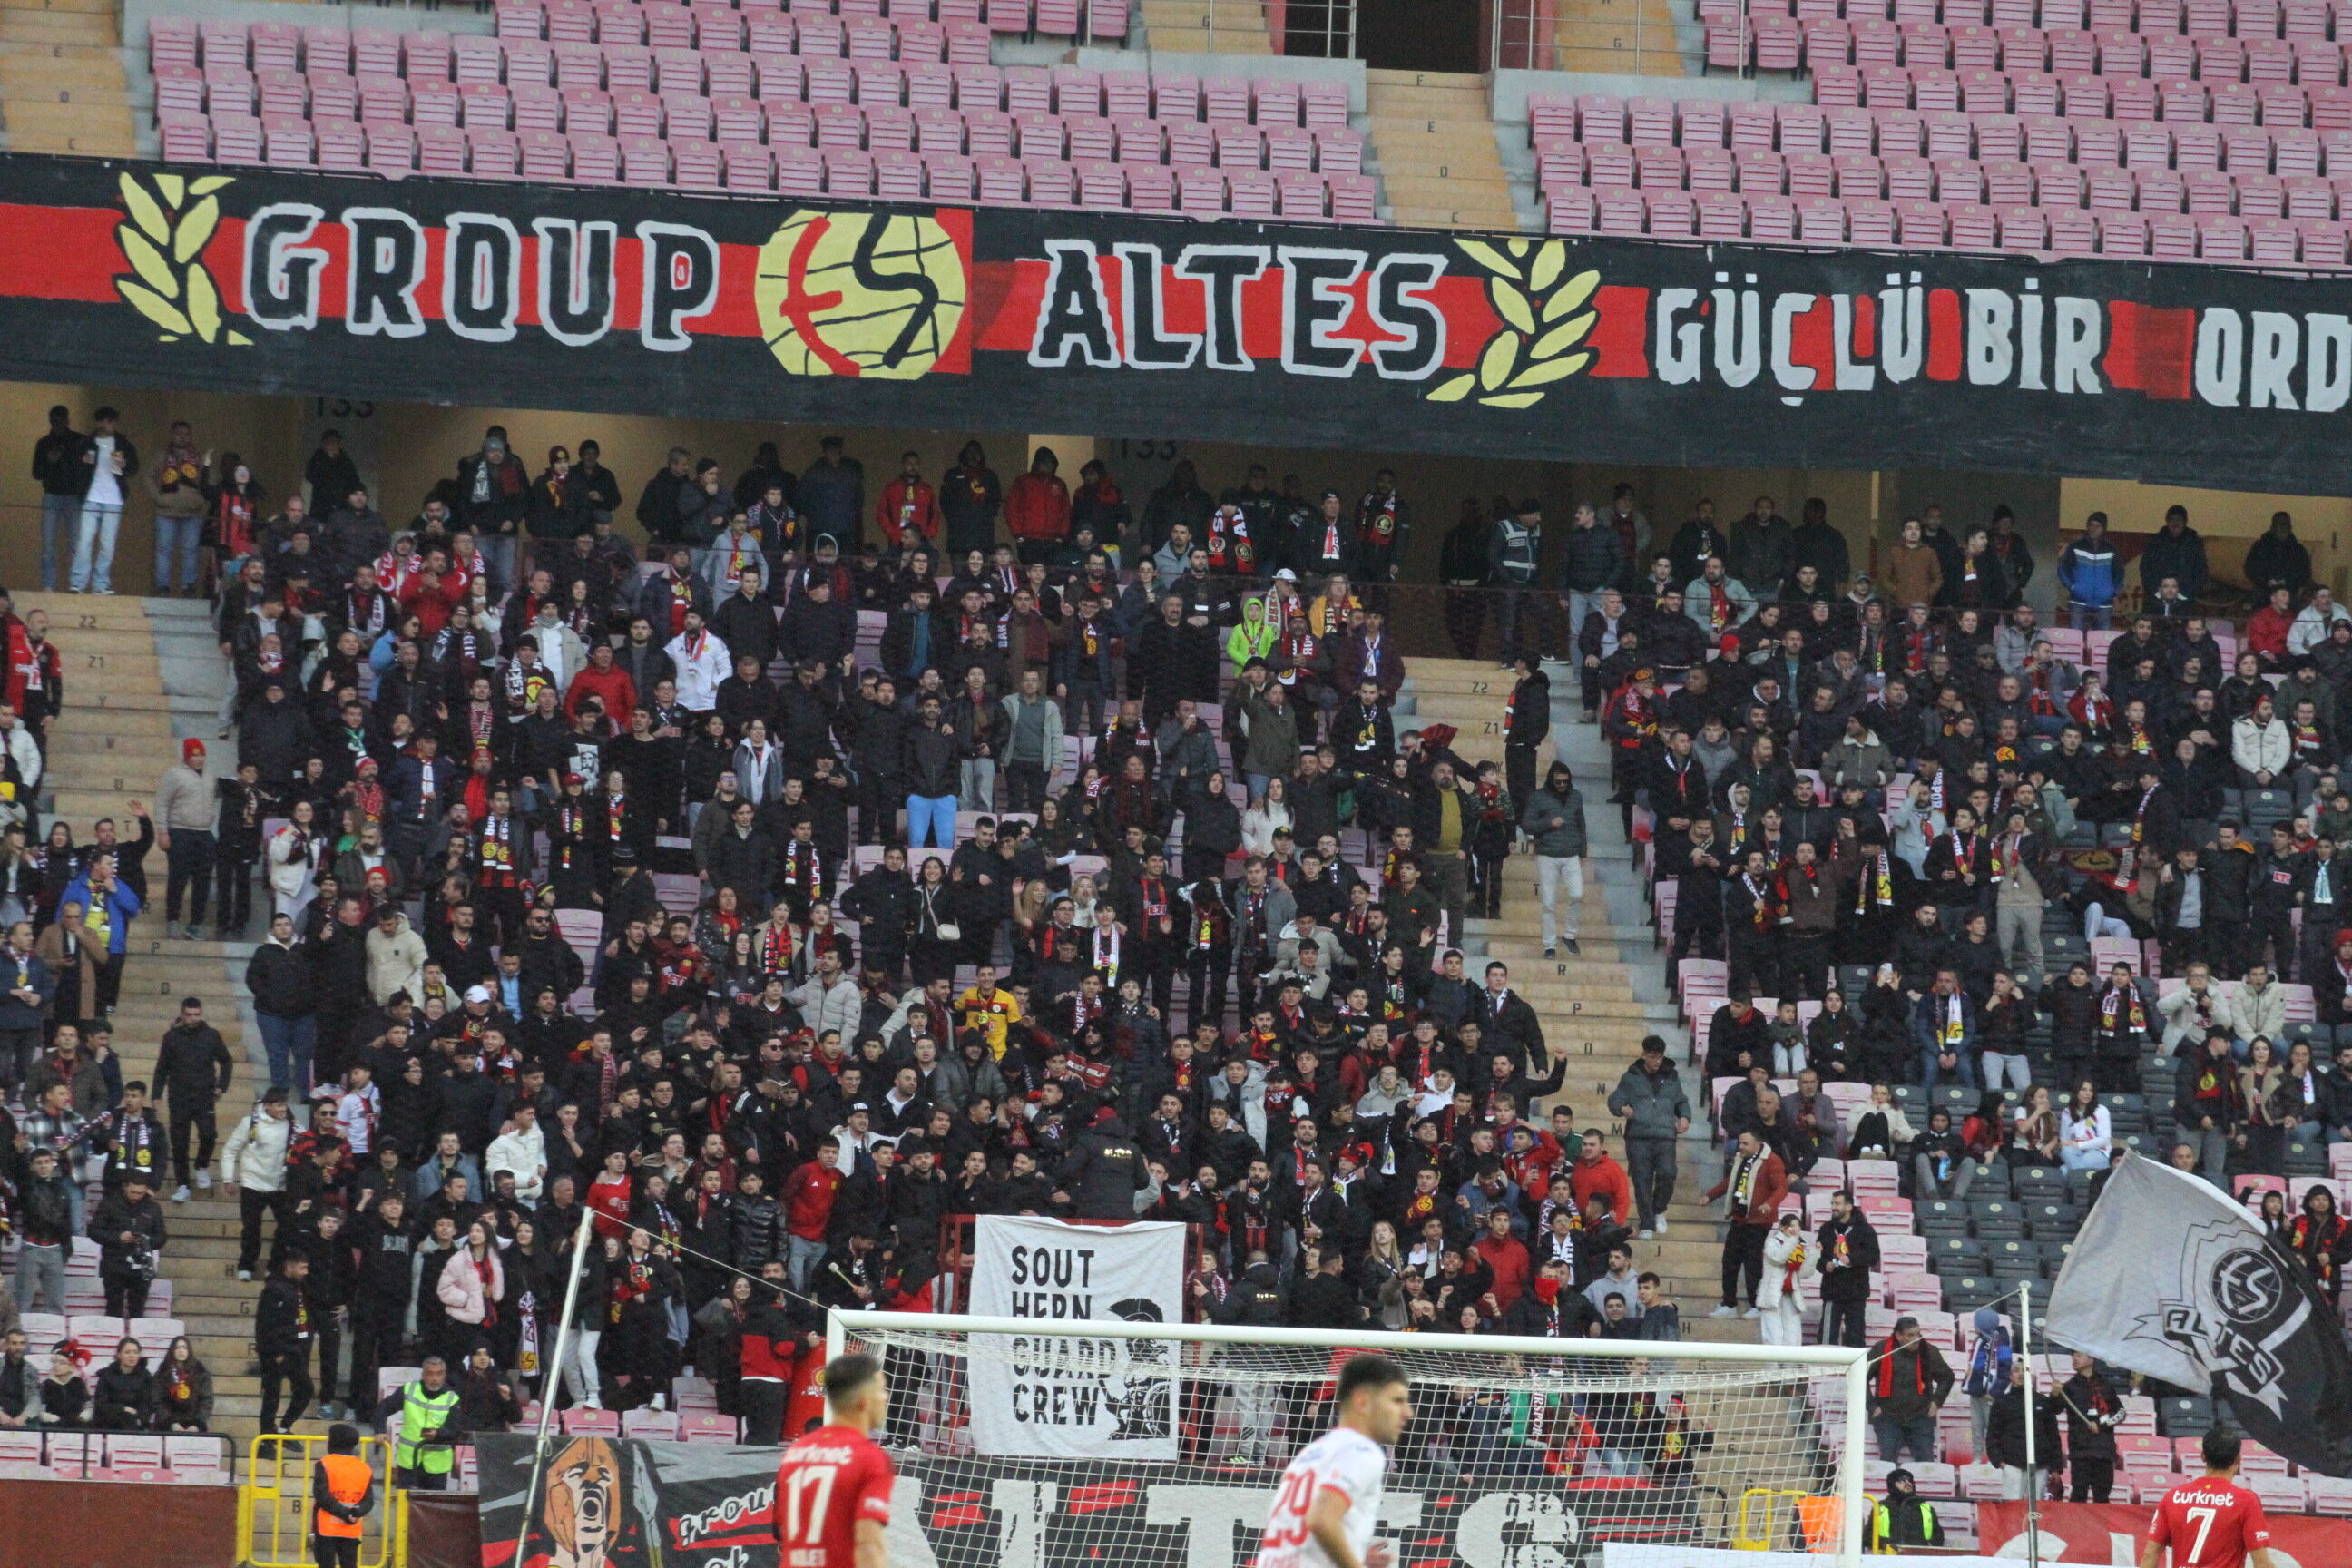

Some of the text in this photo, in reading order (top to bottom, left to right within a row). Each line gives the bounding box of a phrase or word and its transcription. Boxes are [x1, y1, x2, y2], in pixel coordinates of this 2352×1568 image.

[1416, 75, 1424, 86] F
[1427, 121, 1435, 132] E
[1440, 166, 1448, 178] D
[1452, 211, 1459, 223] C
[243, 201, 720, 352] GROUP
[1028, 238, 1449, 380] ALTES
[1656, 270, 1923, 407] GÜÇLÜ
[1965, 277, 2103, 395] BİR
[1472, 681, 1488, 694] Z2
[1484, 722, 1499, 734] Z1
[1520, 842, 1529, 854] U
[1534, 884, 1540, 896] T
[152, 942, 160, 955] P
[1558, 964, 1566, 975] R
[1573, 1003, 1581, 1014] P
[1597, 1083, 1605, 1095] N
[1612, 1123, 1622, 1135] M
[1011, 1245, 1095, 1289] SOUT
[1682, 1321, 1691, 1334] H
[2165, 1309, 2272, 1385] ALTES
[1012, 1337, 1117, 1380] GUARD
[1012, 1382, 1100, 1426] CREW
[785, 1465, 838, 1544] 17
[2172, 1489, 2235, 1507] turknet
[292, 1500, 301, 1514] B
[679, 1482, 779, 1548] grou
[2186, 1506, 2217, 1564] 7
